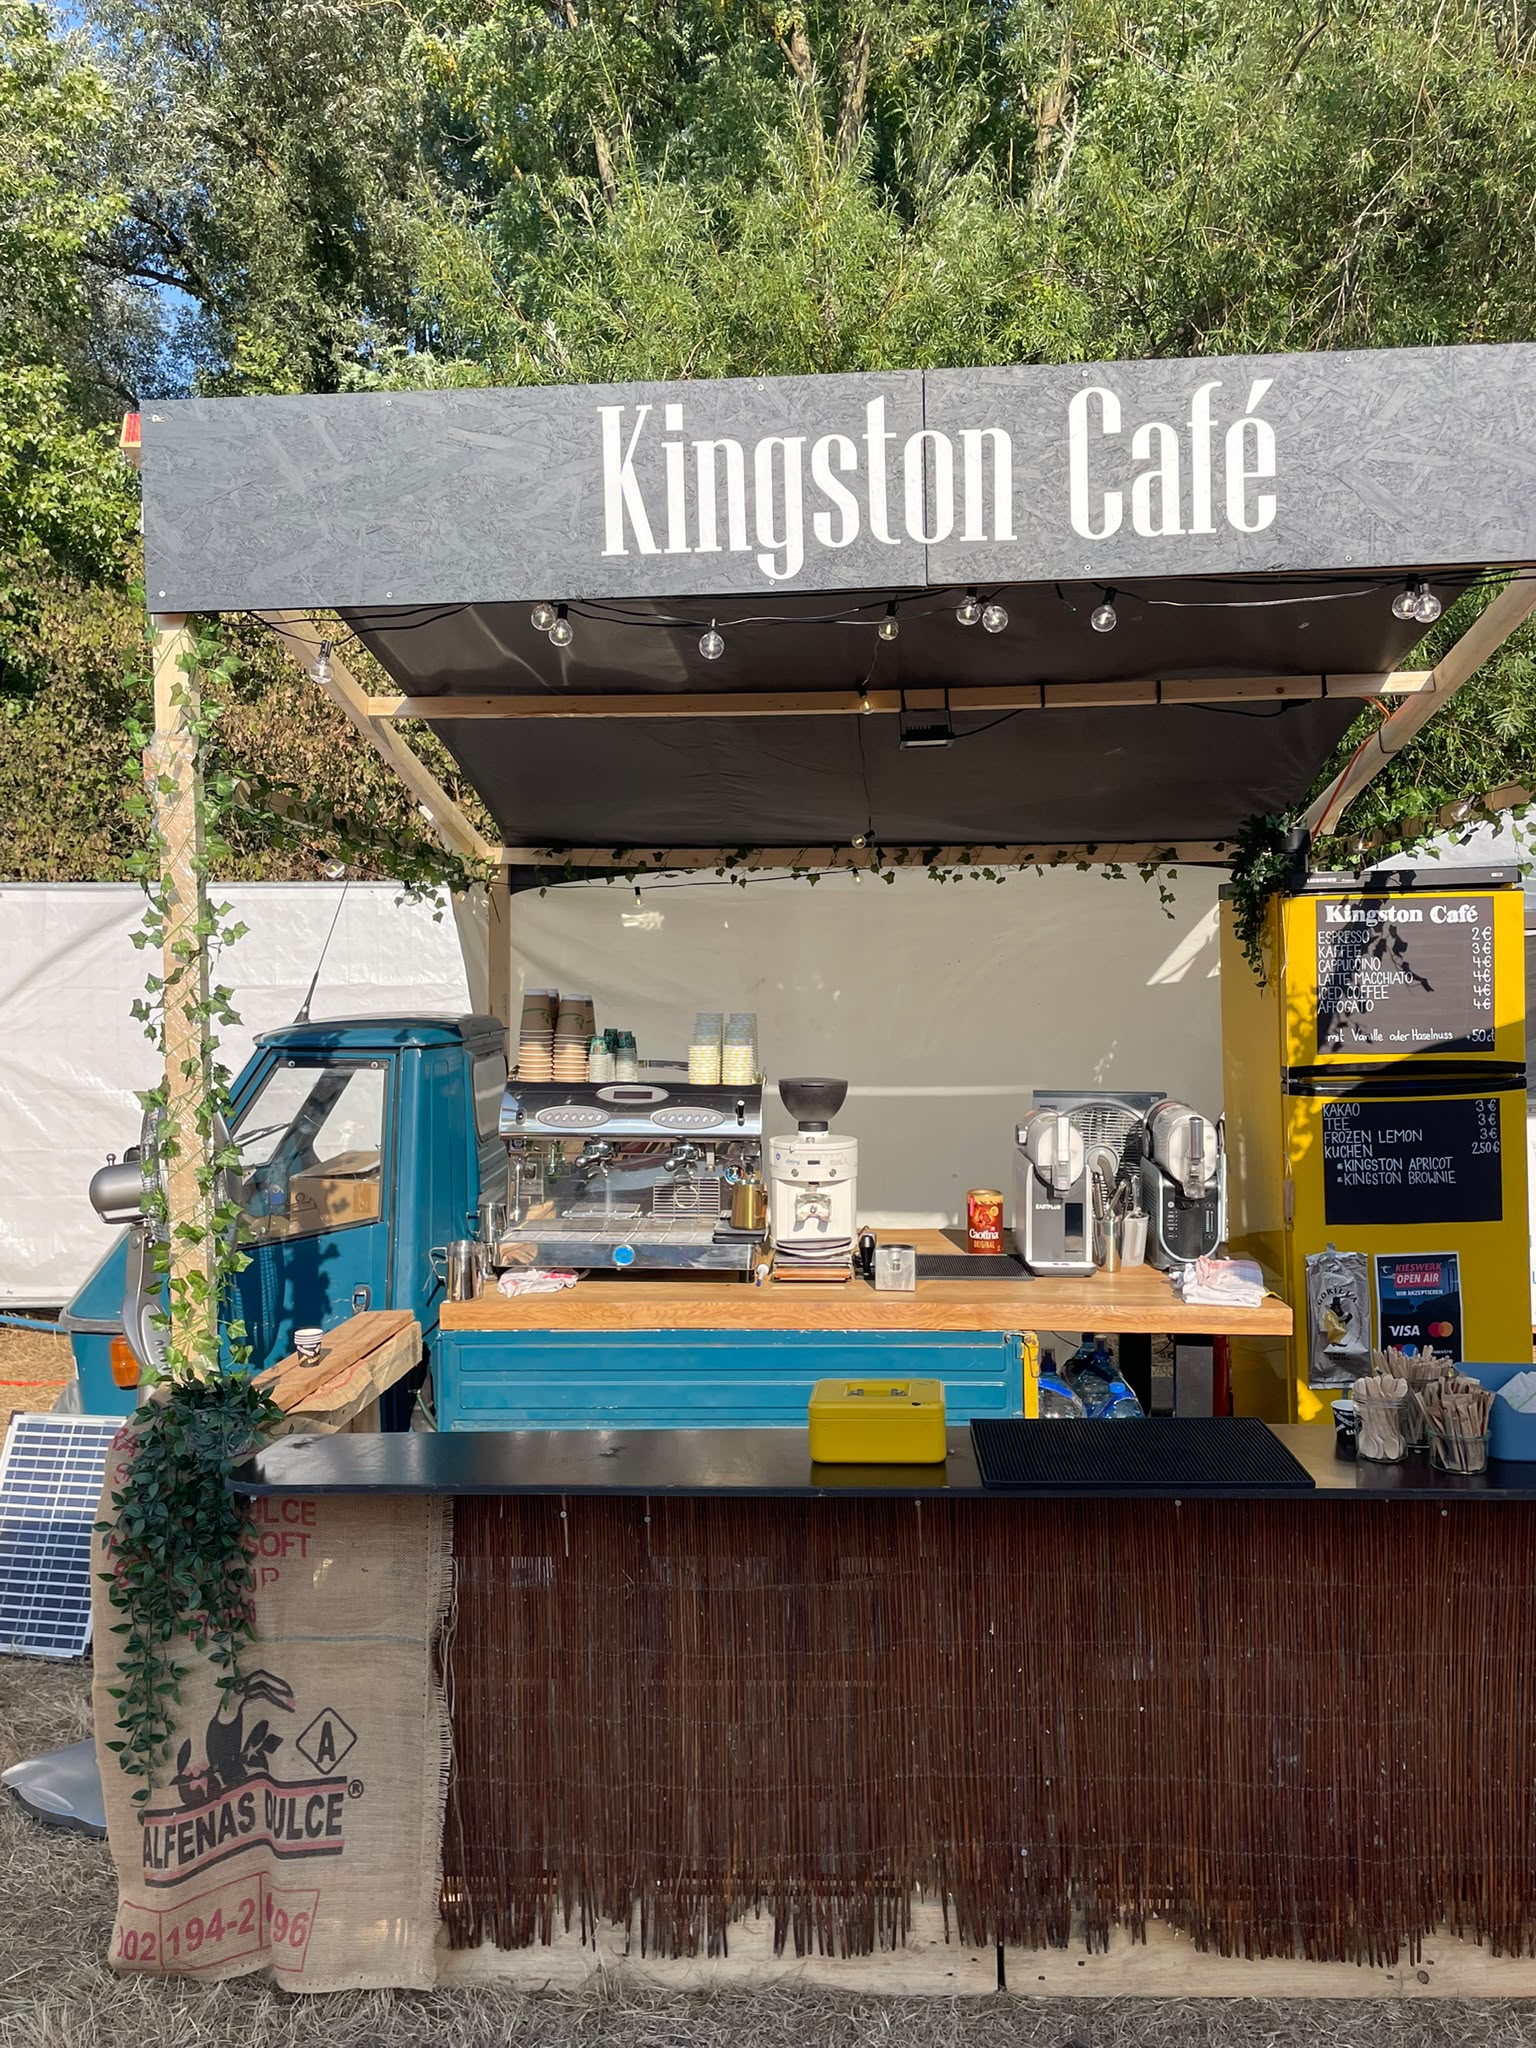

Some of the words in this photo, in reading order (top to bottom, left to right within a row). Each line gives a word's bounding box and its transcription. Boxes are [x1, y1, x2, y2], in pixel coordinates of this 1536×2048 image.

[597, 394, 1018, 580] Kingston
[1069, 379, 1278, 540] Café
[1325, 904, 1423, 927] Kingston
[1430, 904, 1478, 924] Café
[1318, 930, 1370, 944] ESPRESSO
[1318, 944, 1361, 959] KAFFEE
[1318, 957, 1381, 972] CAPPUCCINO
[1318, 972, 1352, 986] LATTE
[1355, 971, 1413, 985] MACCHIATO
[1318, 986, 1343, 1000] ICED
[1347, 985, 1389, 1000] COFFEE
[1318, 1000, 1374, 1014] AFFOGATO
[1327, 1029, 1344, 1042] mit
[1351, 1028, 1384, 1042] Vanille
[1389, 1029, 1410, 1041] oder
[1412, 1028, 1454, 1041] Haselnuss
[1323, 1103, 1360, 1117] KAKAO
[1324, 1117, 1350, 1131] TEE
[1324, 1130, 1371, 1144] FROZEN
[1378, 1129, 1422, 1144] LEMON
[1324, 1144, 1373, 1159] KUCHEN
[1344, 1157, 1402, 1172] KINGSTON
[1408, 1156, 1453, 1171] APRICOT
[1344, 1172, 1401, 1186] KINGSTON
[1408, 1171, 1456, 1185] BROWNIE
[969, 1228, 999, 1240] Caotina
[1395, 1262, 1442, 1272] KIESWERK
[1396, 1273, 1420, 1284] OPEN
[1423, 1273, 1439, 1283] AIR
[1388, 1325, 1420, 1337] VISA
[246, 1497, 317, 1526] ULCE
[244, 1531, 311, 1558] SOFT
[316, 1720, 336, 1763] A
[143, 1792, 256, 1869] ALFENAS
[264, 1788, 344, 1840] DULCE
